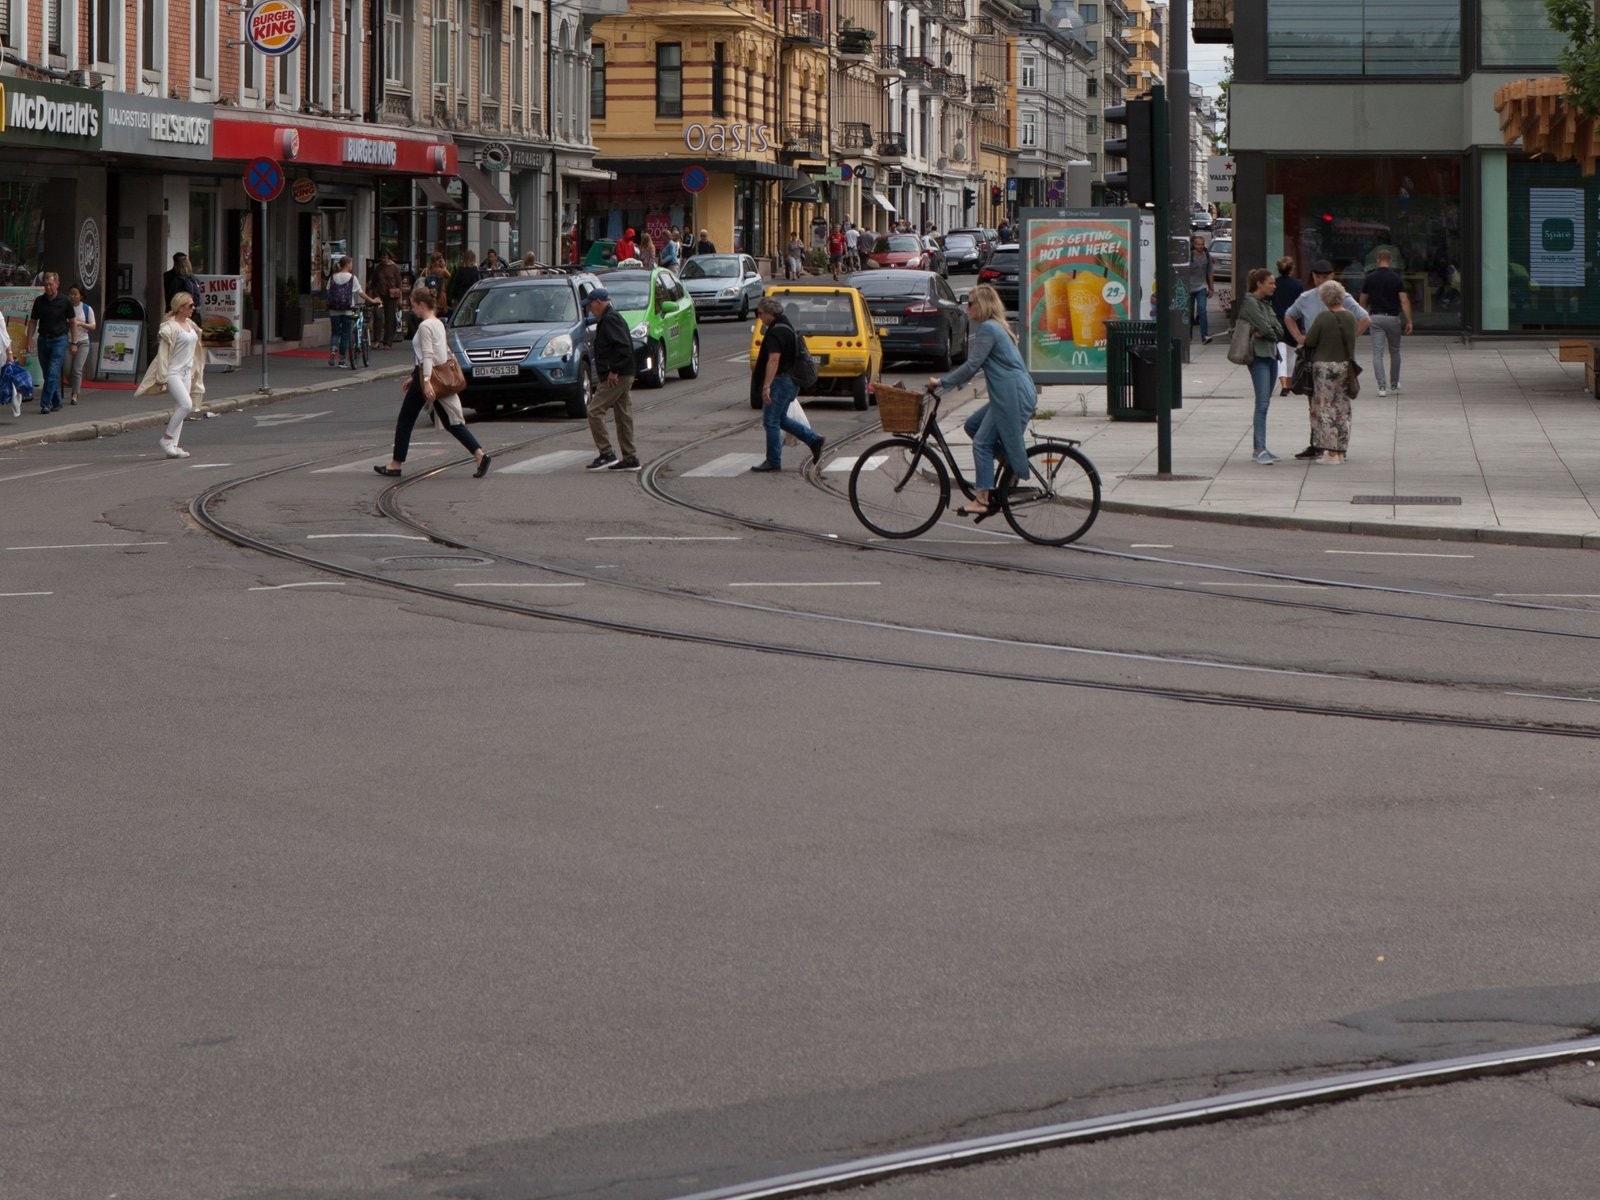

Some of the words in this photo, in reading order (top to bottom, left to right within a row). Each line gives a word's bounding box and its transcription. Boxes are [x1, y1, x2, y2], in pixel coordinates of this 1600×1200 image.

[253, 10, 295, 28] BURGER
[253, 19, 296, 42] KING
[10, 92, 99, 137] McDonald's
[108, 107, 151, 129] MAJORSTUEN
[151, 113, 211, 145] HELSEKOST
[686, 123, 769, 152] oasis
[346, 137, 379, 165] BURGER
[379, 141, 397, 166] KING
[294, 186, 315, 198] KING
[1046, 234, 1065, 245] IT'S
[1067, 230, 1113, 244] GETTING
[1039, 248, 1062, 261] HOT
[1067, 246, 1080, 257] IN
[1085, 241, 1122, 255] HERE!
[209, 279, 237, 292] KING
[204, 294, 225, 306] 39,-
[490, 366, 517, 375] 45138
